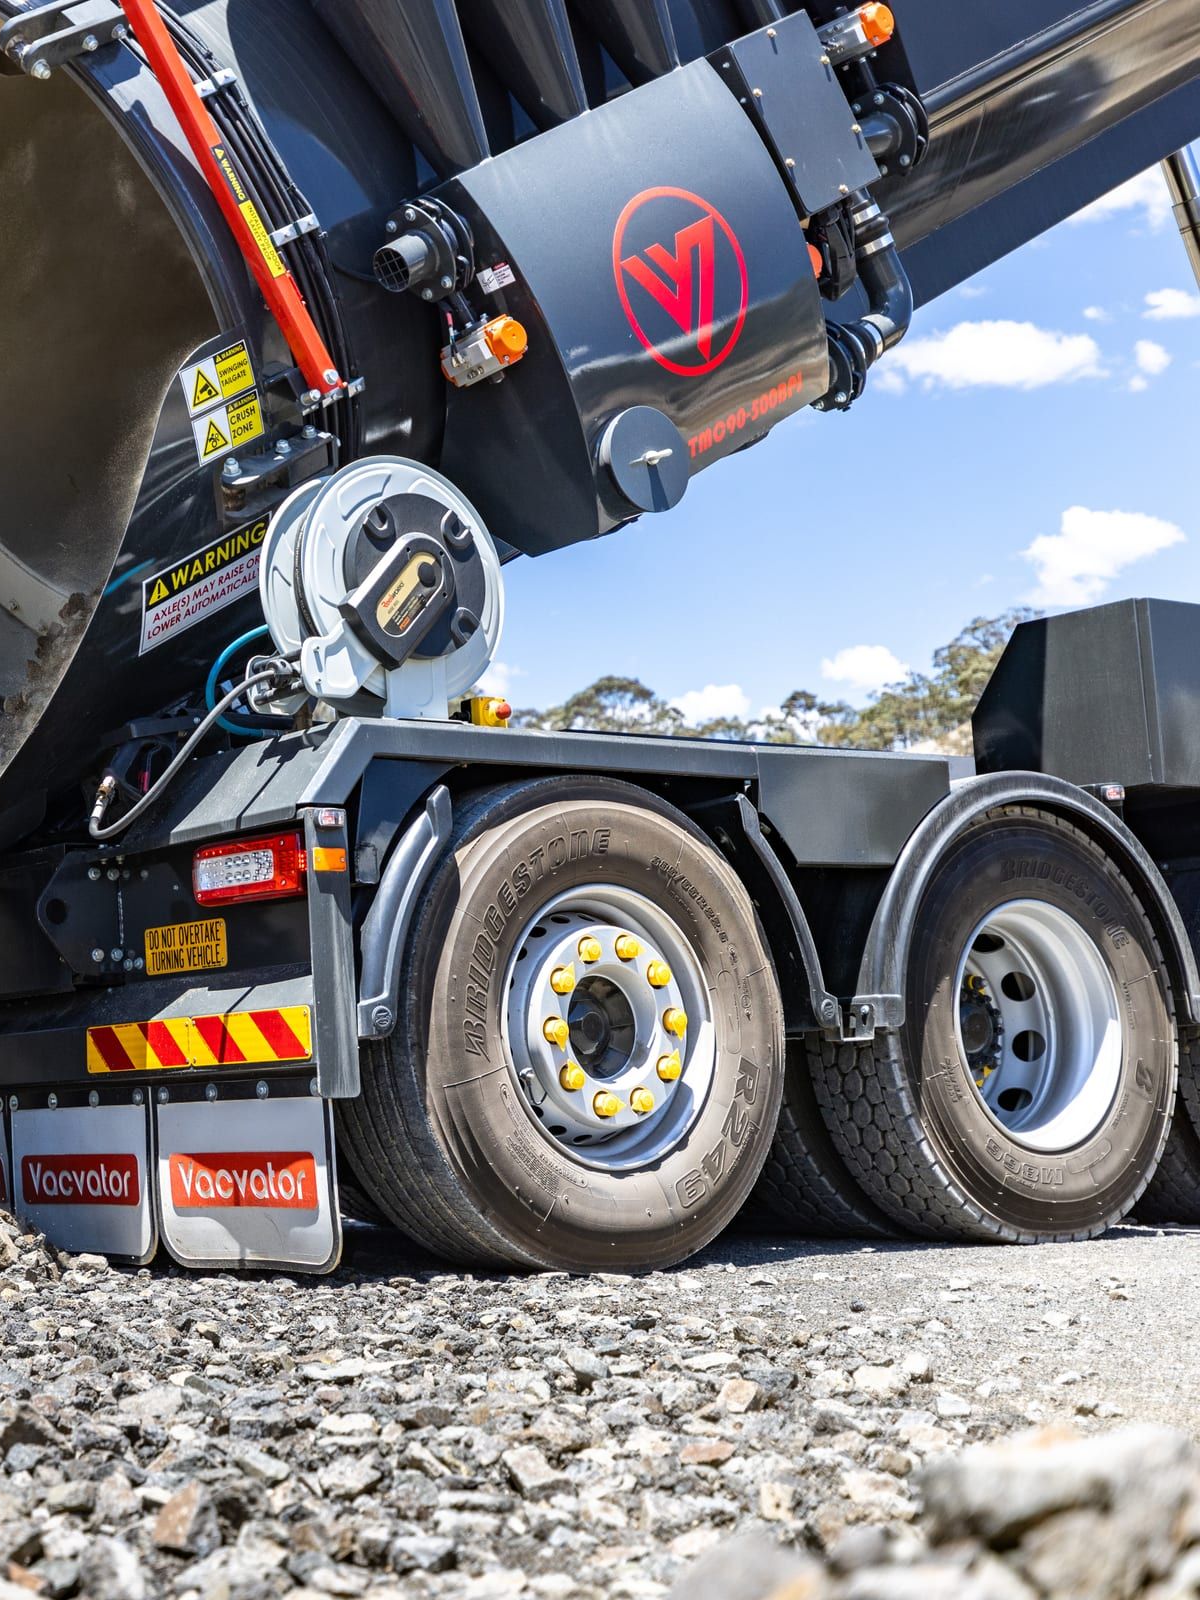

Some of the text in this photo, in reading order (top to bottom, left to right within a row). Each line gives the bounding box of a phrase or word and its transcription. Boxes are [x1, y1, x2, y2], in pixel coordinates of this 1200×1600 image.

[221, 158, 246, 200] WARNING
[221, 344, 244, 360] WARNING
[220, 358, 248, 378] SWINGING
[222, 370, 247, 386] TAILGATE
[230, 406, 256, 425] CRUSH
[234, 394, 256, 410] WARNING
[232, 421, 254, 439] ZONE
[171, 522, 265, 591] WARNING
[153, 594, 190, 623] AXLE(S)
[192, 580, 216, 600] MAY
[218, 564, 244, 586] RAISE
[147, 613, 181, 640] LOWER
[1000, 859, 1130, 950] BRIDGESTONE
[149, 921, 221, 950] DO NOT OVERTAKE
[463, 827, 611, 1062] BRIDGESTONE
[151, 944, 220, 972] TURNING VEHICLE
[674, 1055, 760, 1208] R249
[29, 1161, 131, 1198] Vacvator
[178, 1160, 306, 1200] Vacvator
